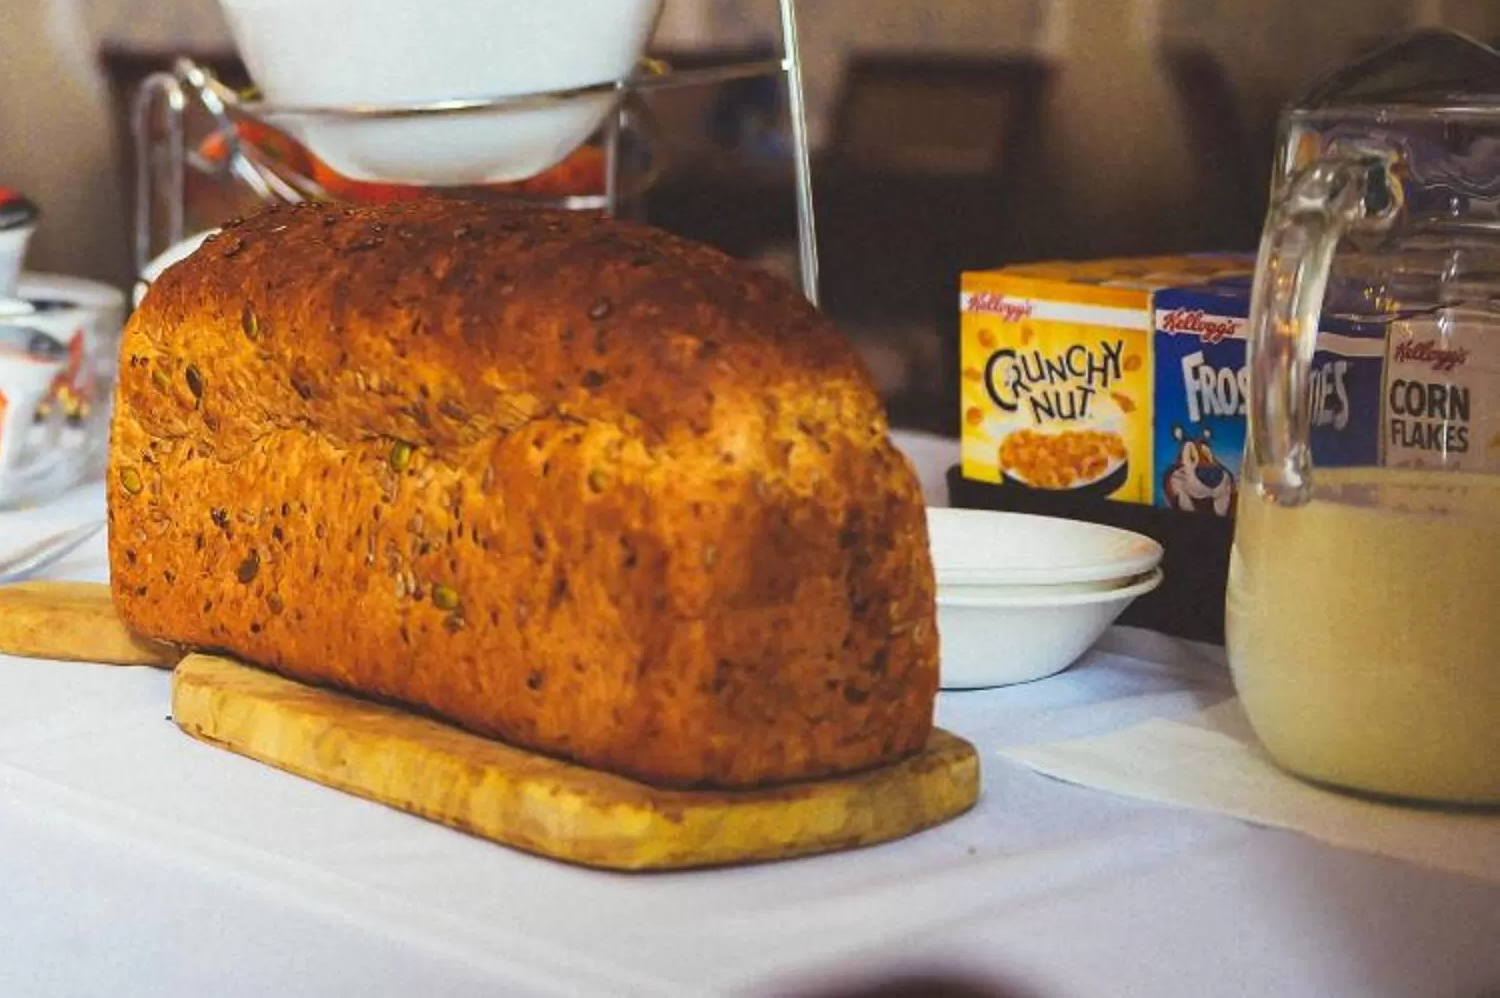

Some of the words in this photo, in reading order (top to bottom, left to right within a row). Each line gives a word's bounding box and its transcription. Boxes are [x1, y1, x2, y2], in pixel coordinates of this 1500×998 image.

[1162, 308, 1238, 343] Kellogg's
[984, 339, 1124, 413] CRUNCHY
[1029, 386, 1096, 424] NUT
[1390, 378, 1470, 422] CORN
[1391, 418, 1470, 453] FLAKES
